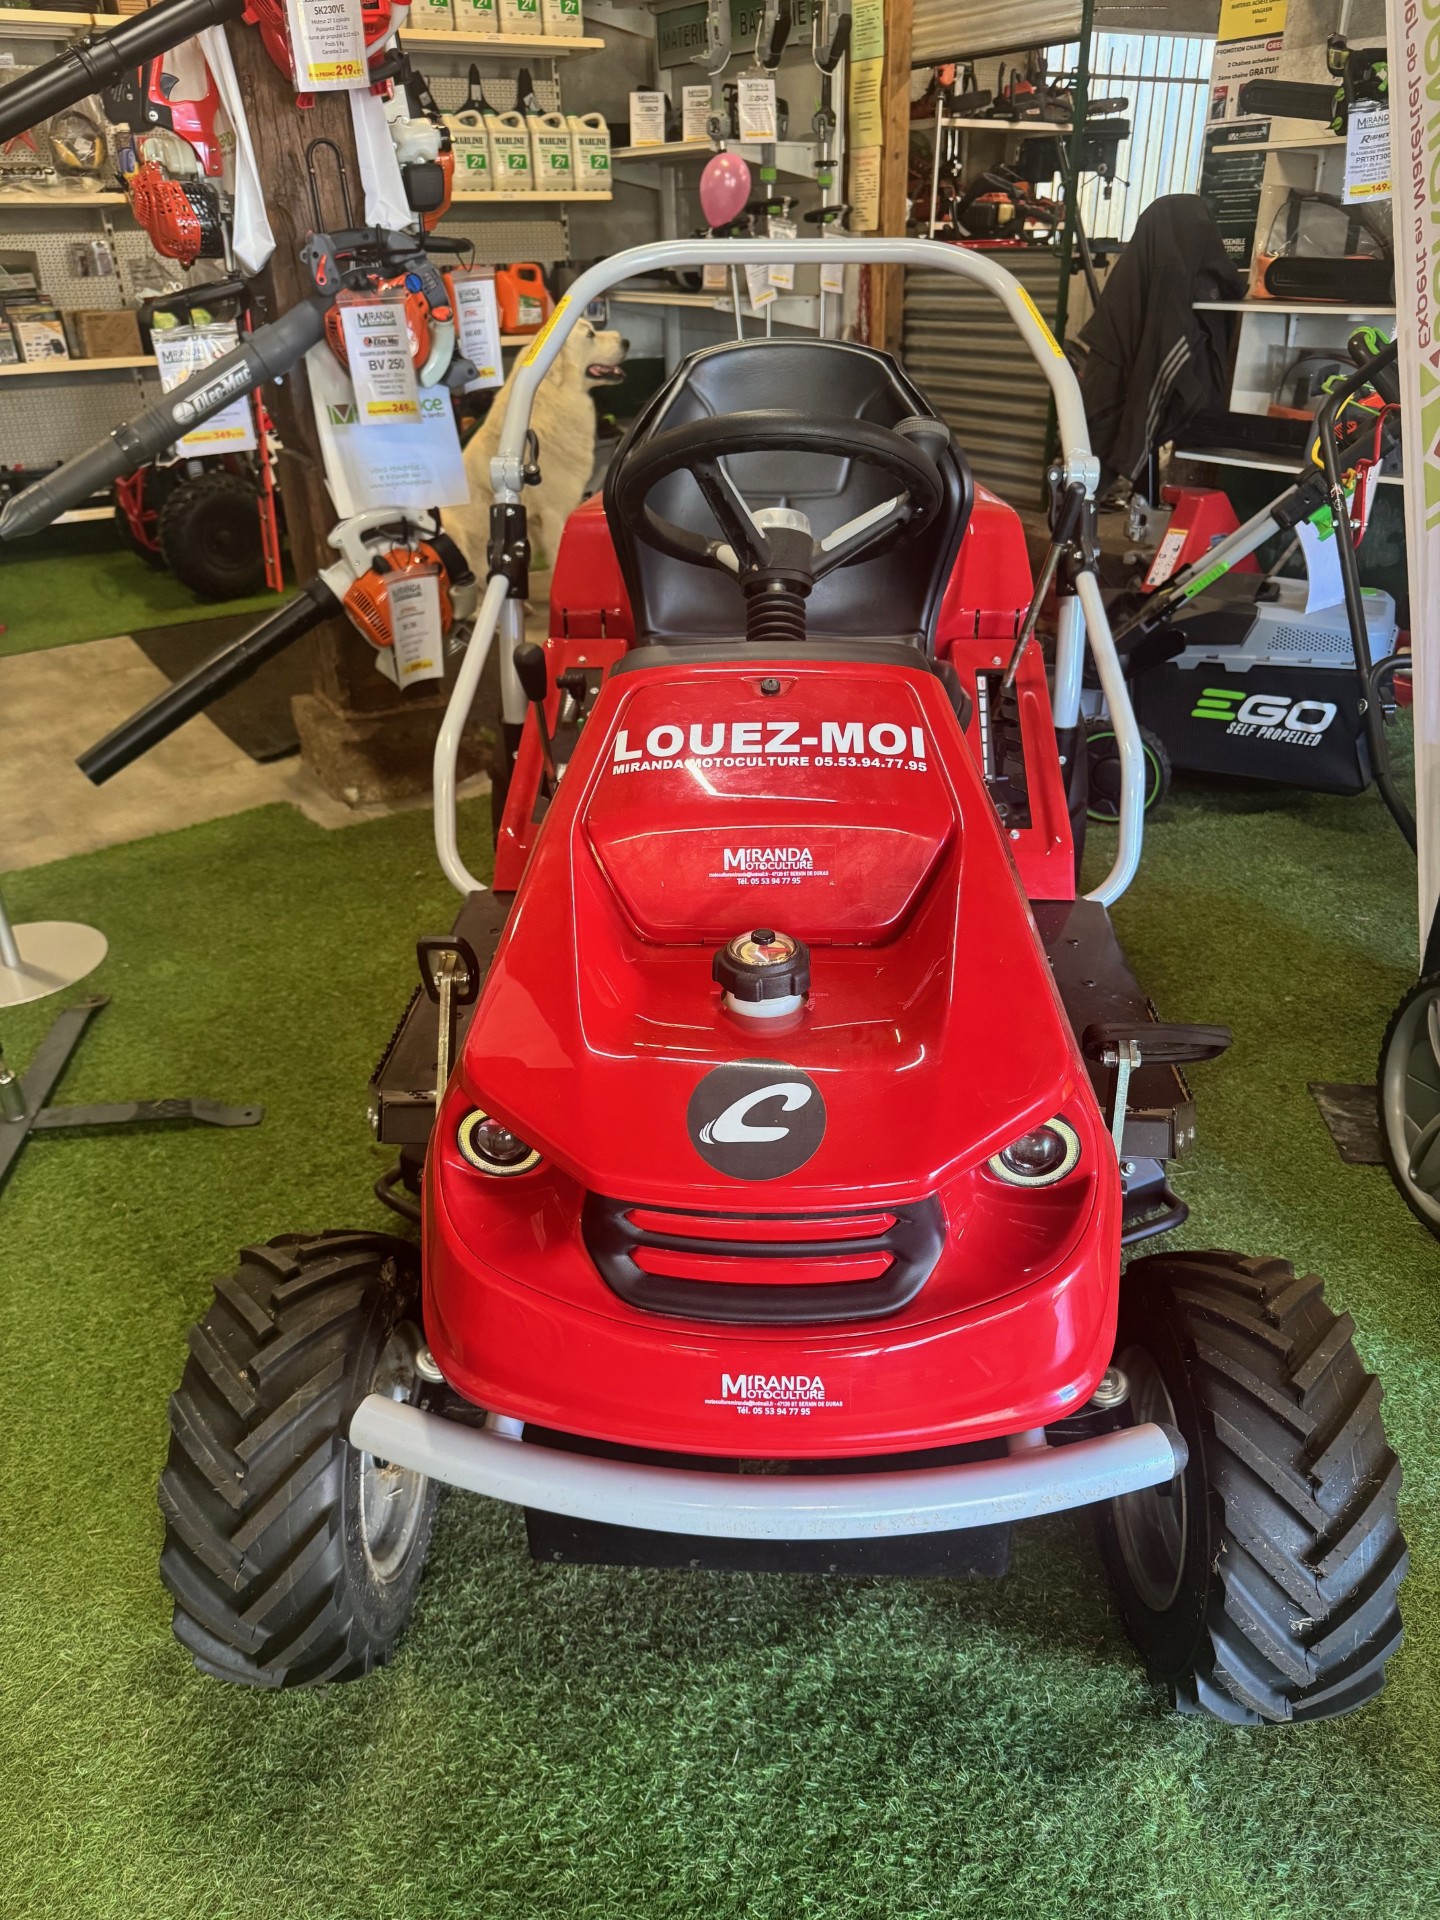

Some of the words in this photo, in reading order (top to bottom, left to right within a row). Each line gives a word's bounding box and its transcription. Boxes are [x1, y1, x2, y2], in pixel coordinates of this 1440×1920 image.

[1216, 46, 1246, 55] PROMOTION
[336, 64, 353, 76] 219
[470, 156, 483, 168] 2T
[512, 157, 524, 168] 2T
[555, 157, 566, 168] 2T
[594, 157, 605, 168] 2T
[1371, 183, 1387, 192] 149
[368, 360, 384, 370] BV
[388, 358, 405, 370] 250
[1191, 688, 1338, 734] EGO
[1226, 722, 1255, 736] SELF
[1256, 726, 1322, 746] PROPELLED
[613, 722, 926, 762] LOUEZ-MOI
[612, 760, 682, 776] MIRANDA
[686, 756, 810, 768] MOTOCULTURE
[814, 756, 928, 772] 05.53.94.77.95
[737, 1406, 750, 1414] Tél.
